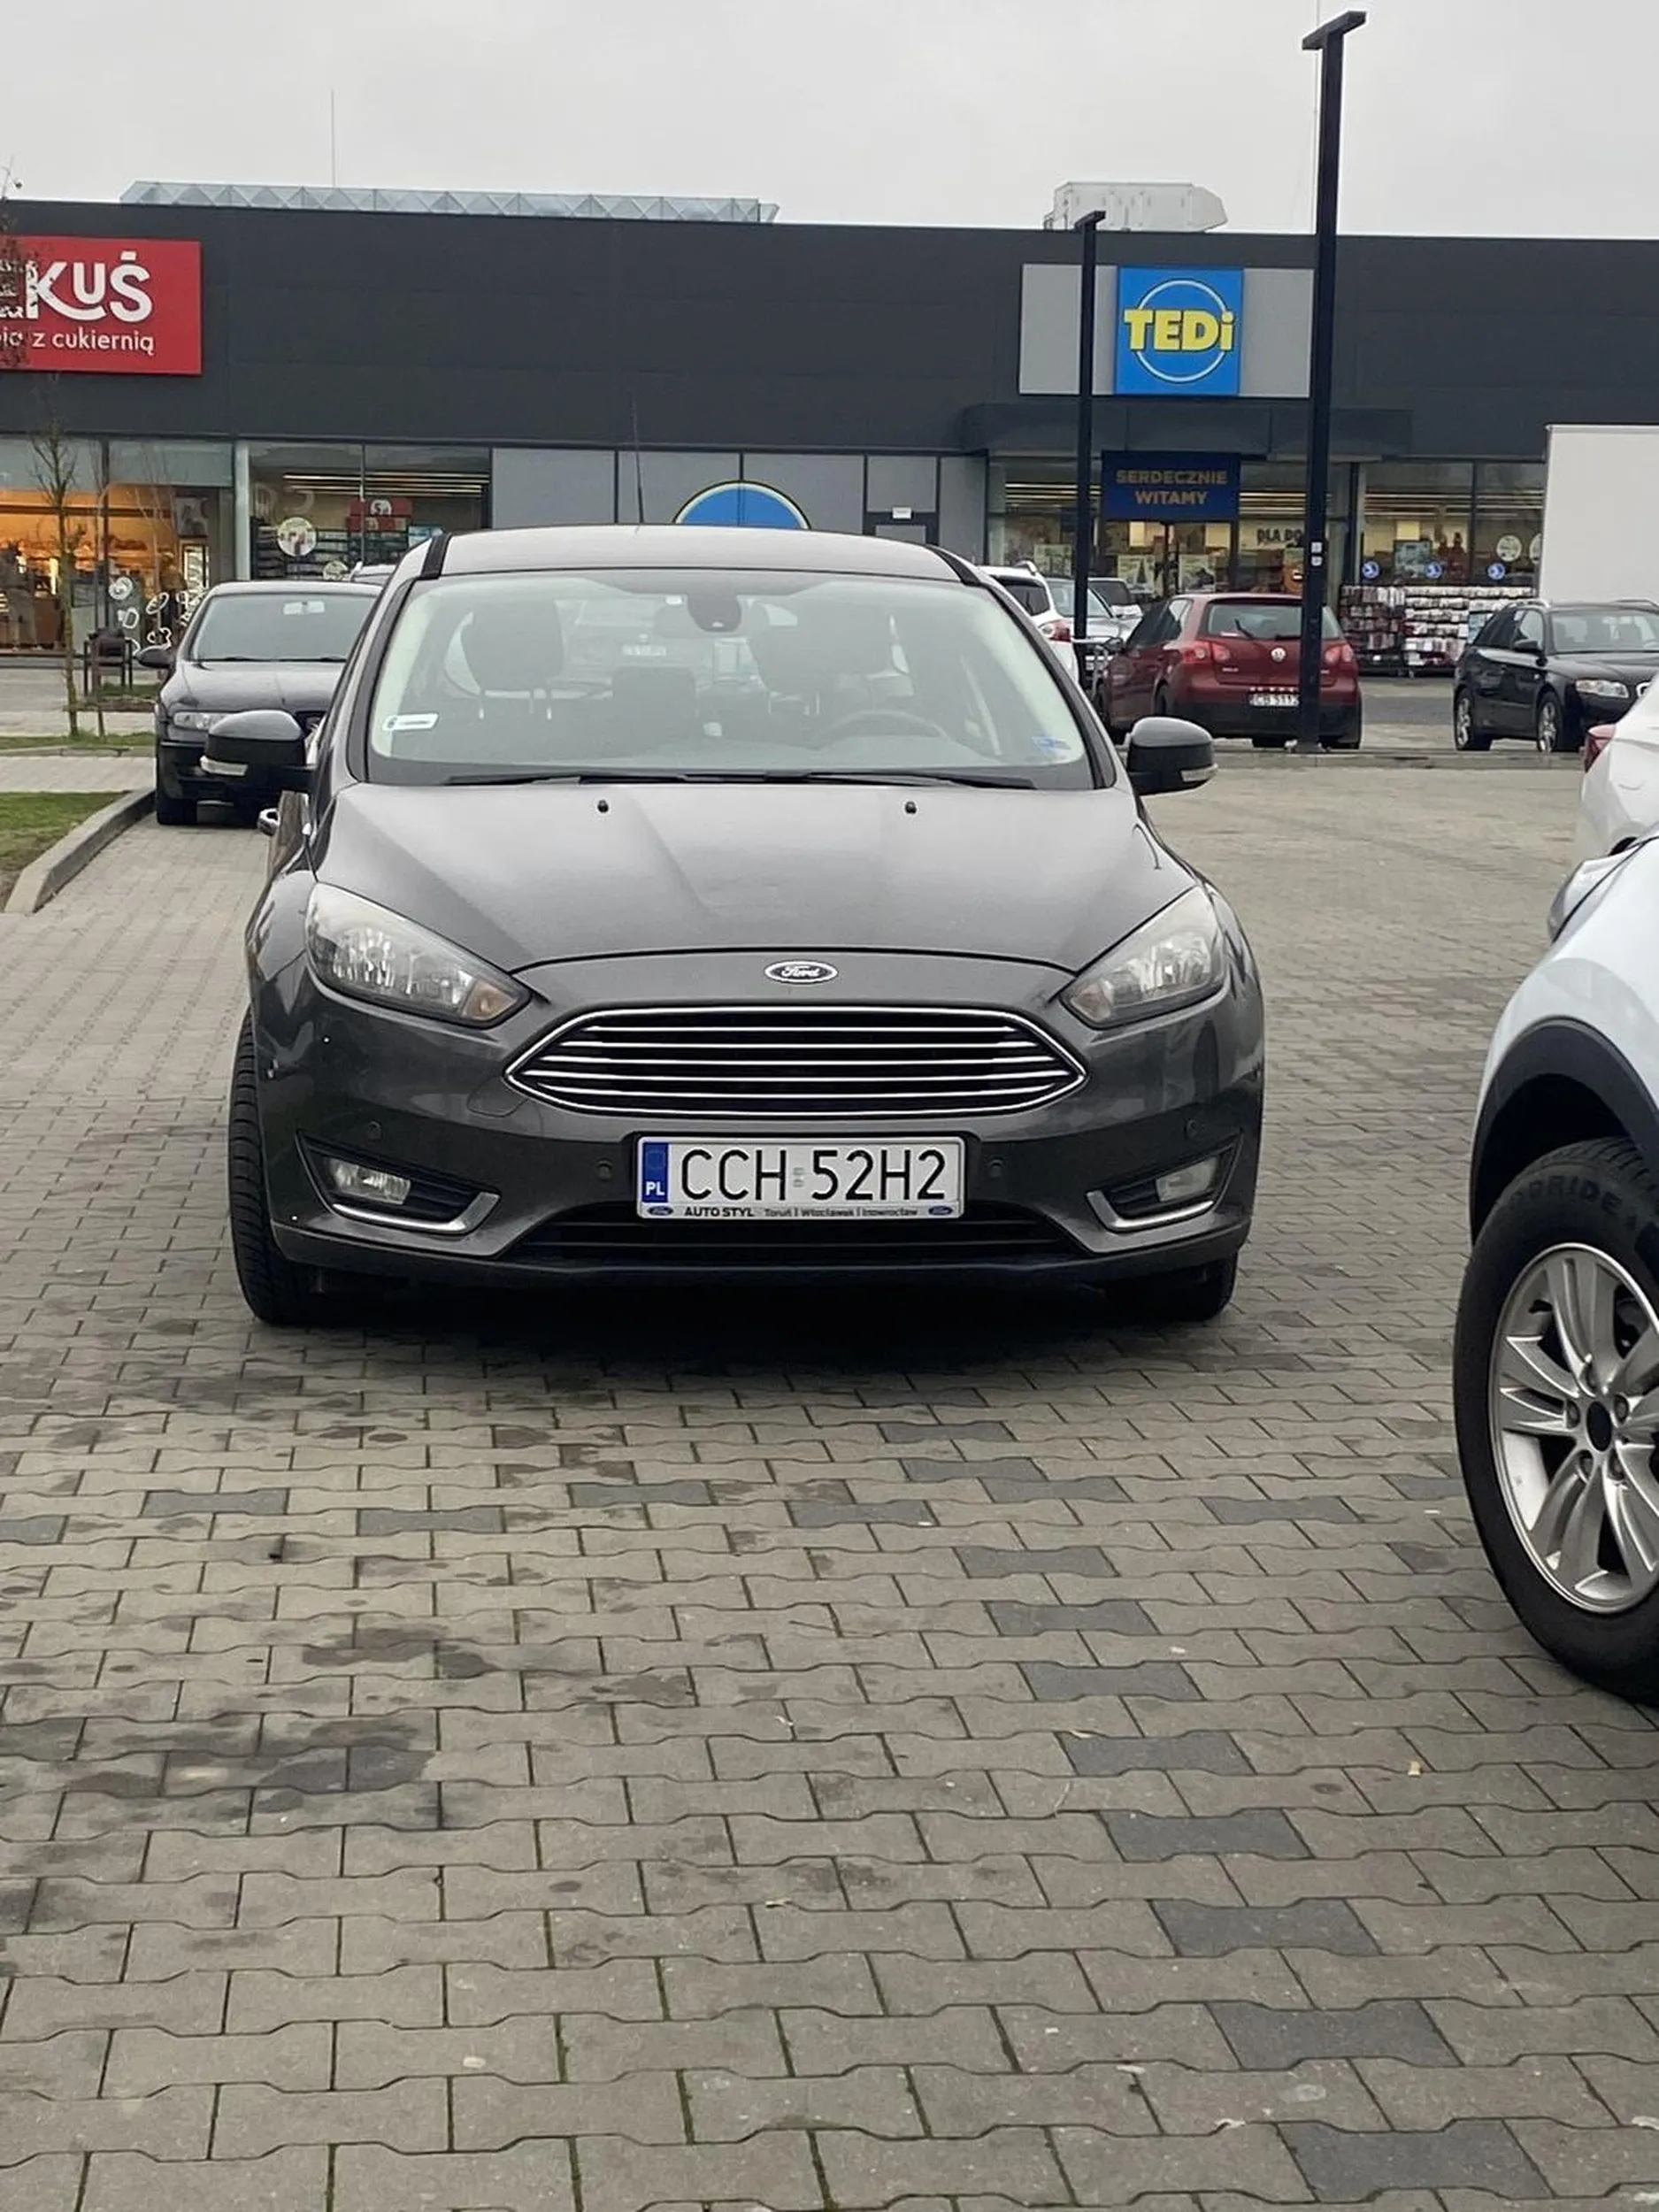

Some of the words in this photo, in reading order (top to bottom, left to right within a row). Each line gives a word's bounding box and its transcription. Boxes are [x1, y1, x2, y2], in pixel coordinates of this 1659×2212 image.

[1124, 310, 1234, 351] TEDi
[32, 332, 46, 348] z
[52, 326, 155, 356] cukiernią
[1116, 470, 1228, 484] SERDECZNIE
[1134, 491, 1208, 504] WITAMY
[680, 1148, 787, 1201] CCH
[810, 1148, 946, 1201] 52H2
[646, 1182, 664, 1195] PL
[684, 1207, 719, 1217] AUTO
[722, 1207, 754, 1217] STYL
